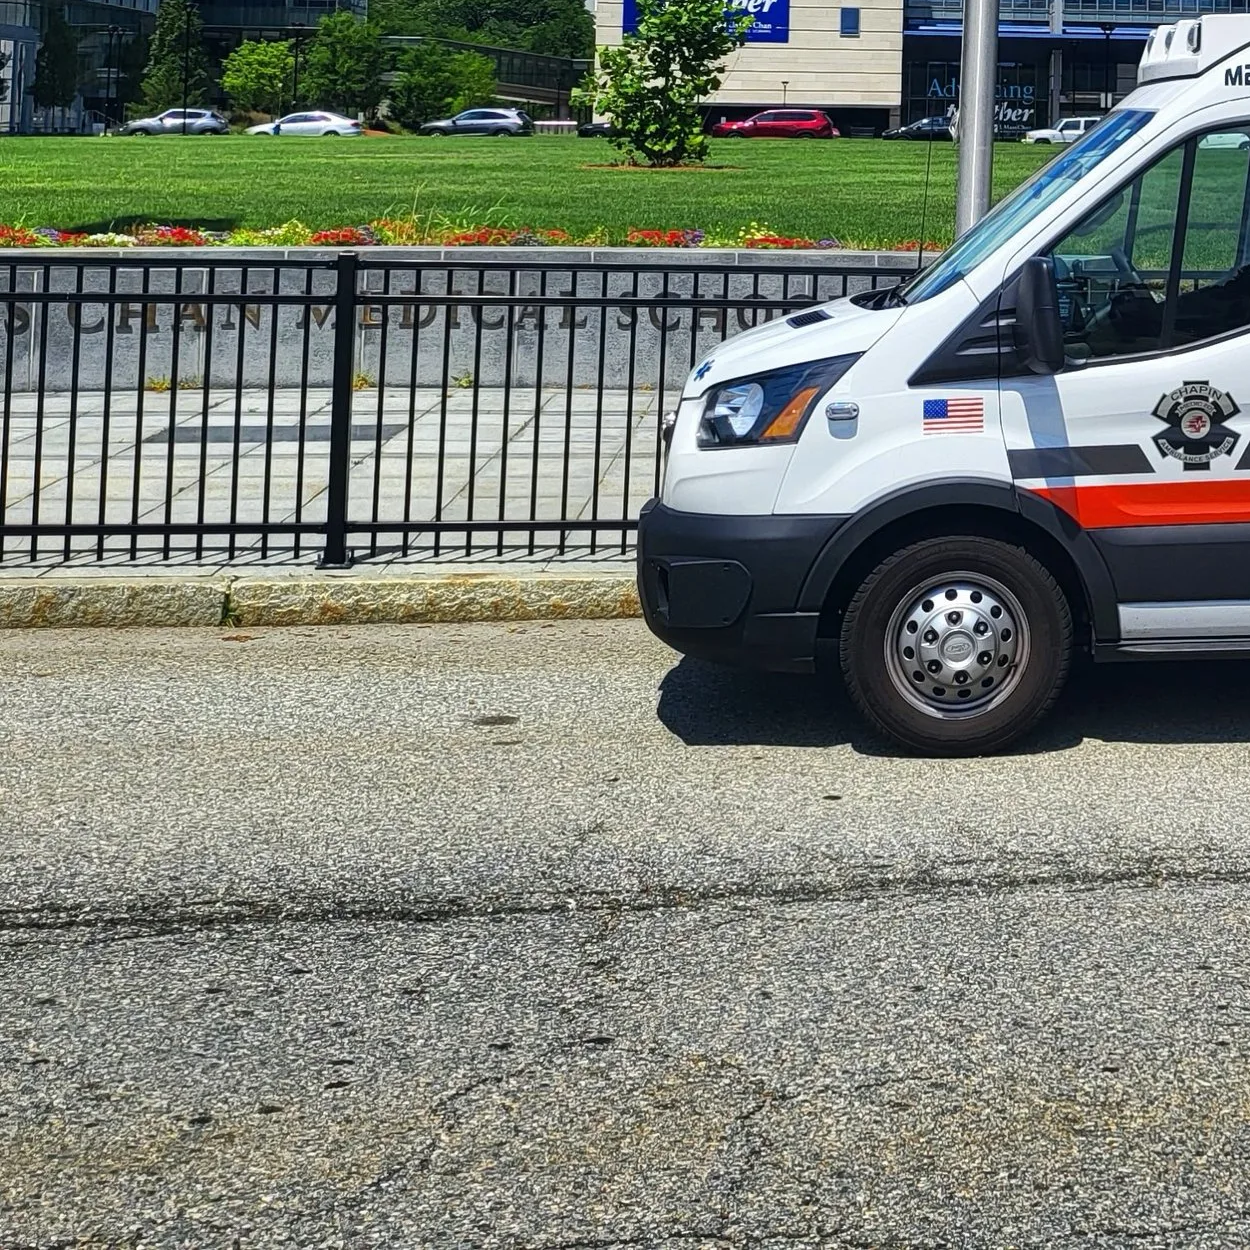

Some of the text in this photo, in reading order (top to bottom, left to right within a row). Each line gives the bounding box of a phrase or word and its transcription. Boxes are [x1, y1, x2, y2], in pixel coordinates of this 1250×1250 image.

[66, 291, 267, 335] CHAN
[296, 290, 588, 331] MEDICAL
[1170, 385, 1222, 401] CHAPIN
[1160, 438, 1233, 462] AMBULANCE SERVICE
